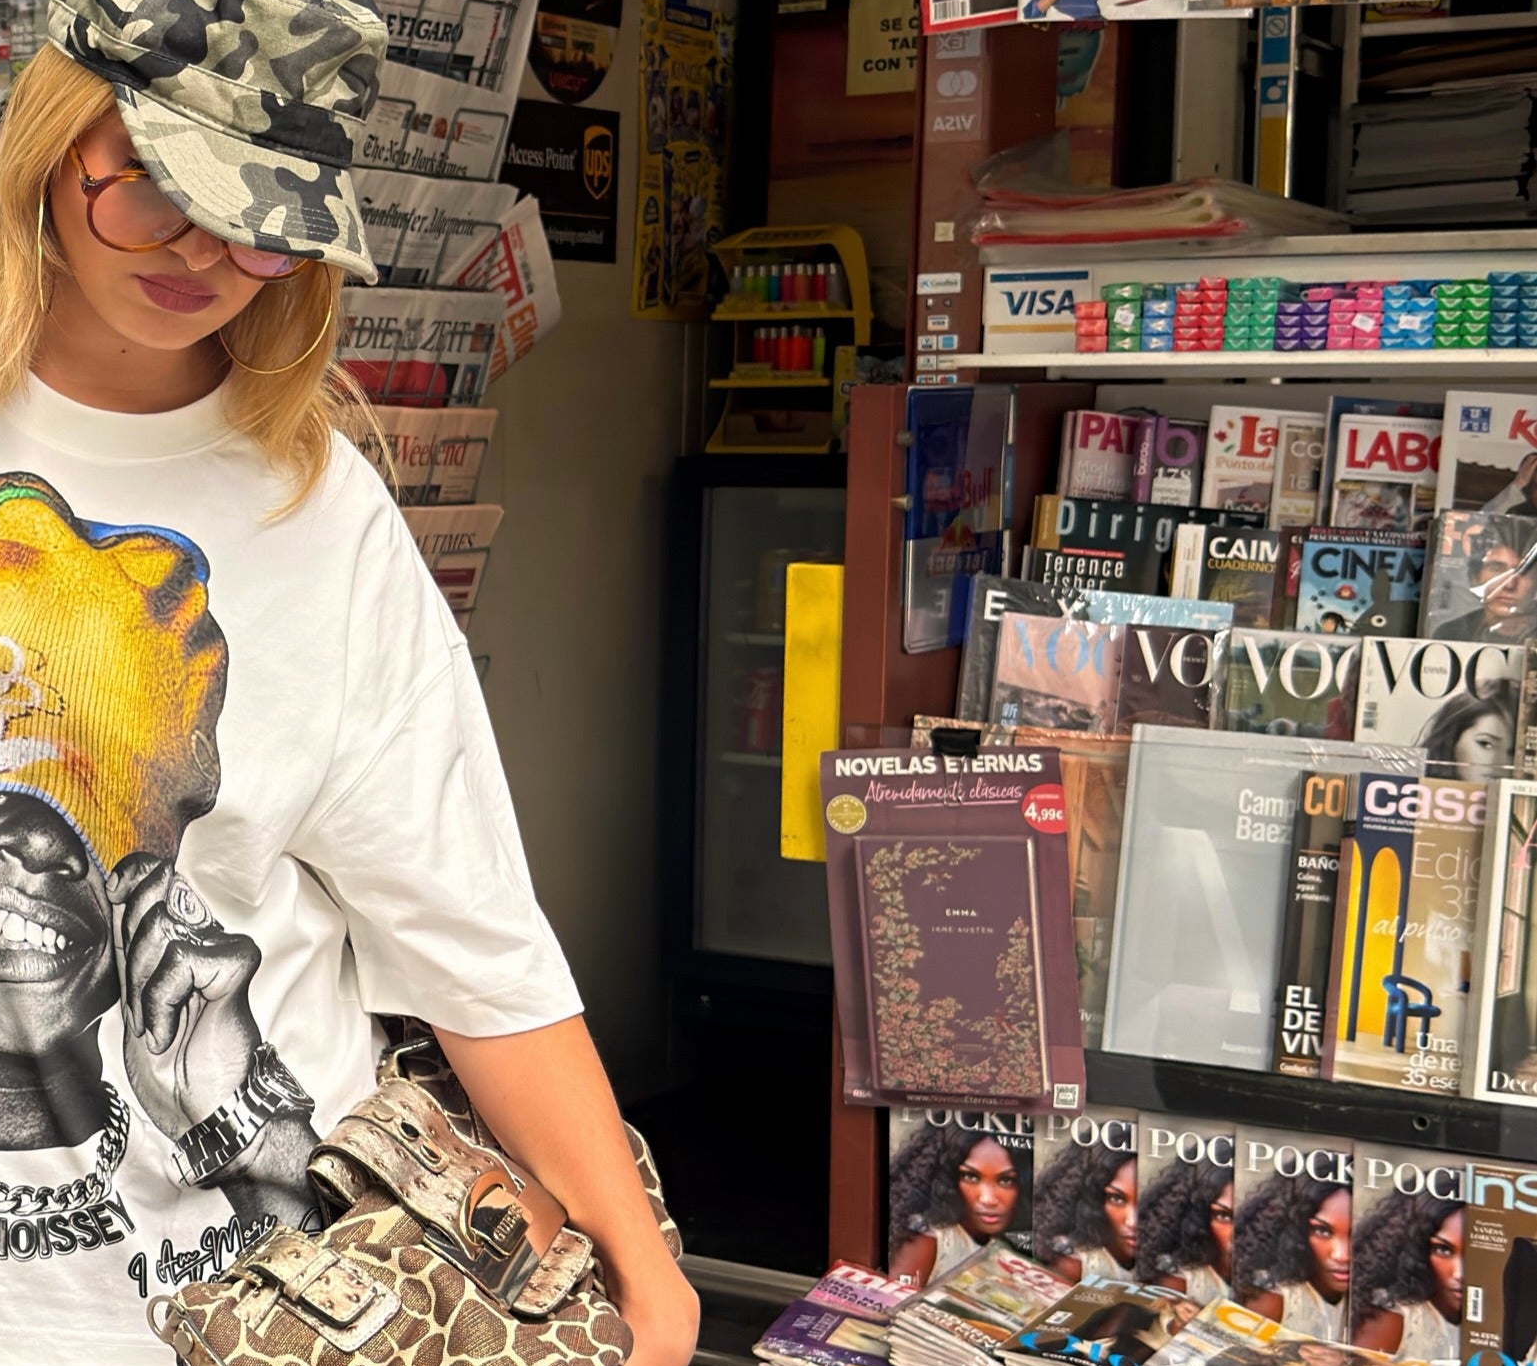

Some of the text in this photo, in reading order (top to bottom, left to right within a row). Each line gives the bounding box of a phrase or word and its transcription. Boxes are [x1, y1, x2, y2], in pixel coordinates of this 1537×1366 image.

[399, 11, 463, 42] FIGARO
[508, 144, 575, 170] Access Point
[585, 147, 610, 186] ups
[1005, 290, 1075, 317] VISA
[1044, 553, 1124, 579] Terence
[835, 756, 937, 777] NOVELAS
[969, 778, 1022, 800] clásicas
[946, 908, 977, 916] EMMA
[1285, 986, 1318, 1007] EL
[1284, 1009, 1321, 1031] DE
